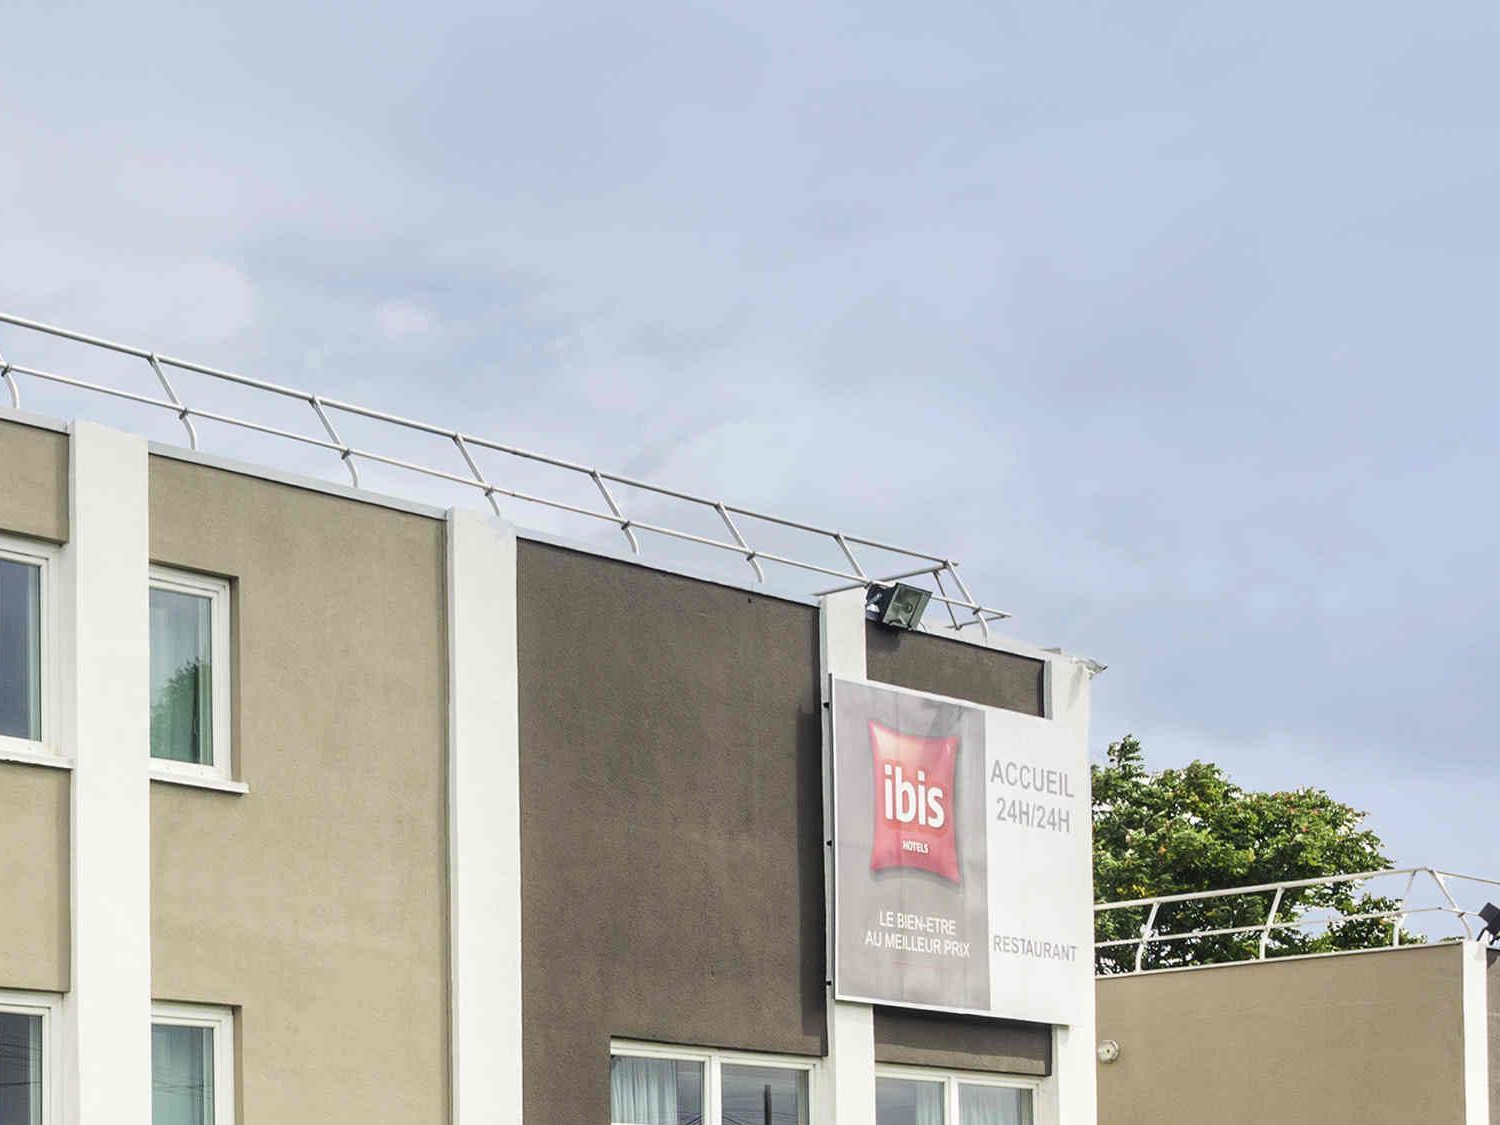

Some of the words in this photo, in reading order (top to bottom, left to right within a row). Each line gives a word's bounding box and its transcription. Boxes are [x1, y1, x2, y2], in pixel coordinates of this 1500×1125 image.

[990, 760, 1075, 798] ACCUEIL
[884, 763, 945, 829] ibis
[996, 797, 1070, 833] 24H/24H
[902, 839, 929, 854] HOTELS
[879, 911, 894, 927] LE
[865, 930, 882, 946] AU
[884, 931, 942, 954] MEILLEUR
[943, 939, 971, 958] PRIX
[993, 935, 1077, 962] RESTAURANT
